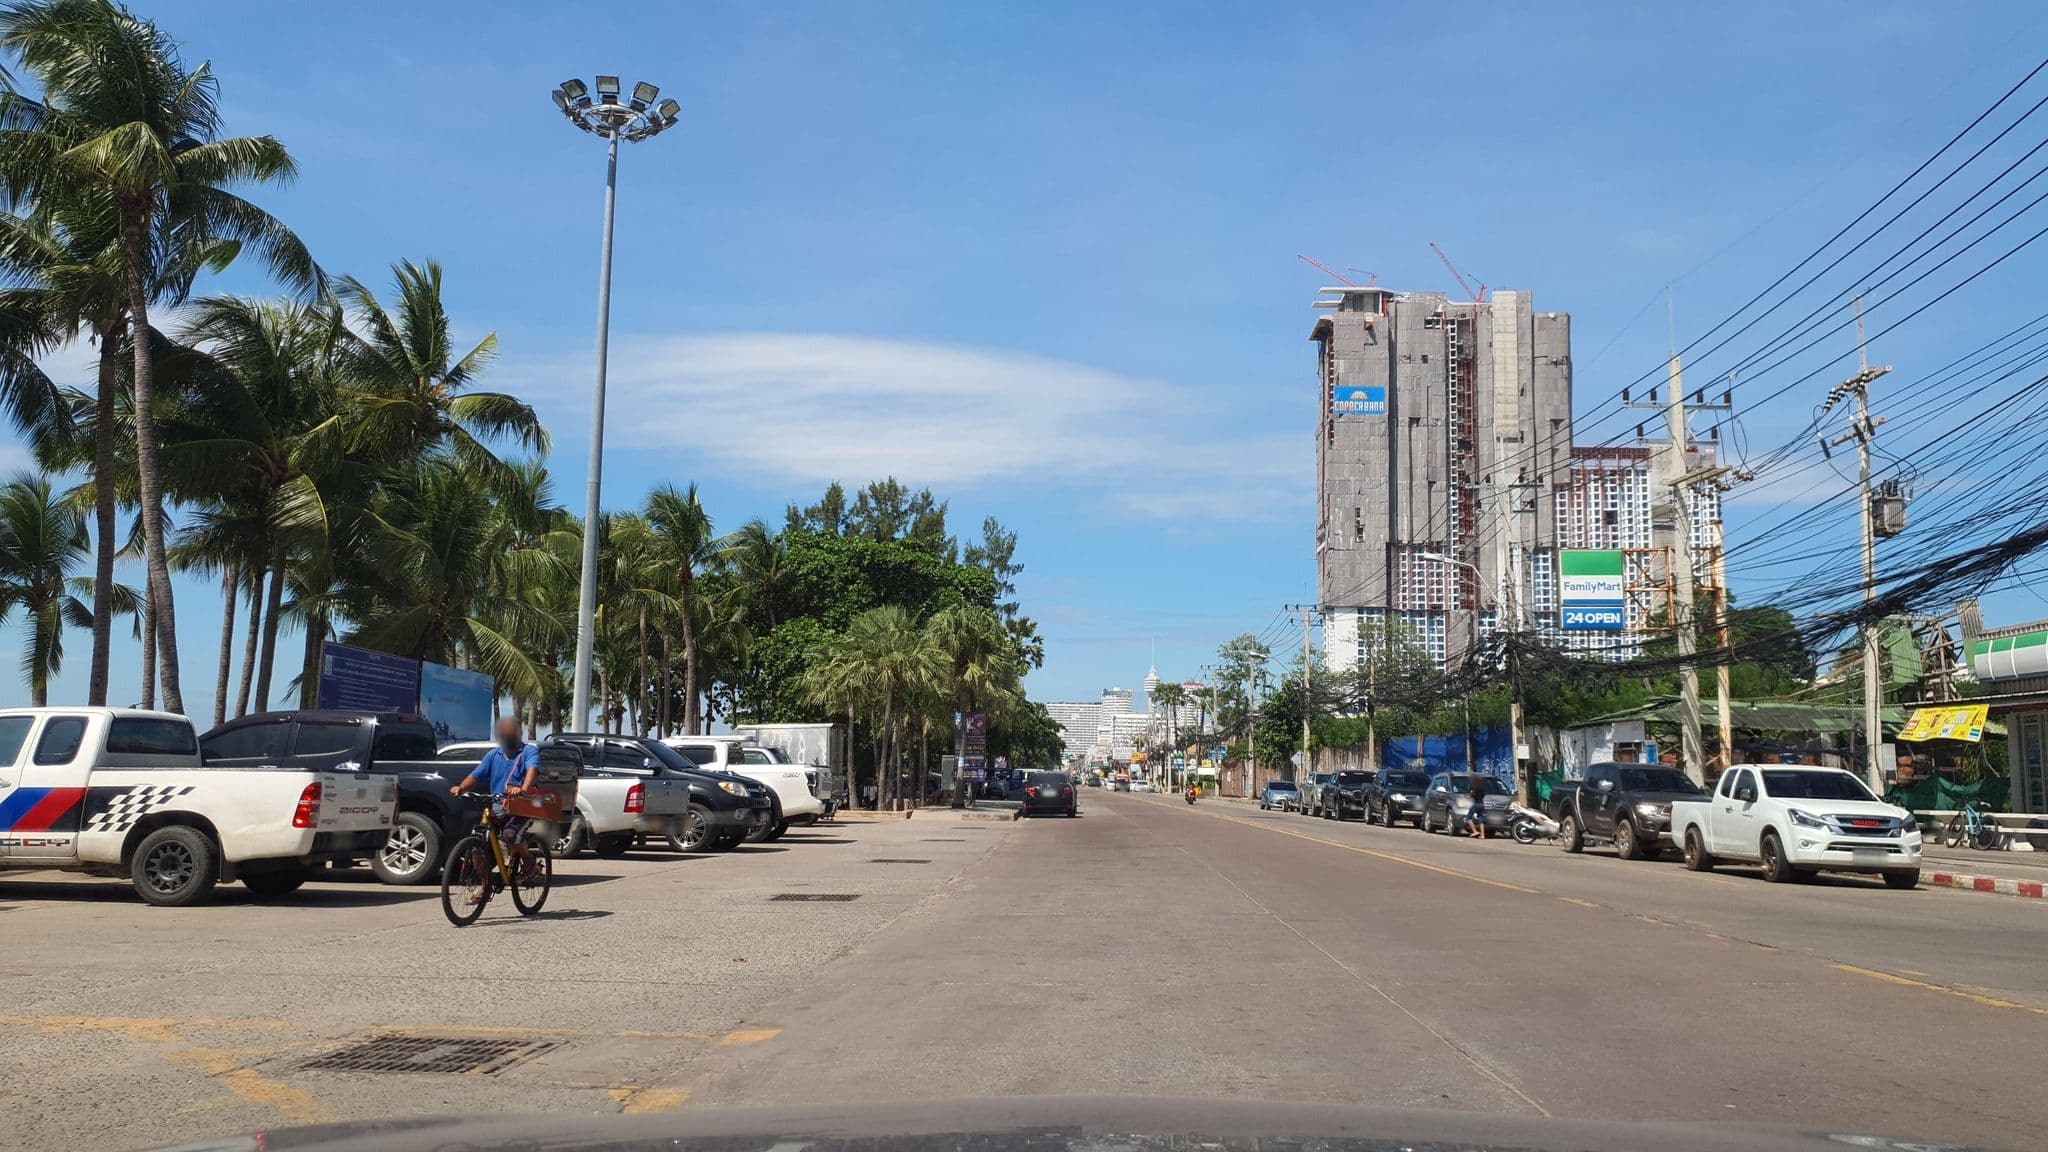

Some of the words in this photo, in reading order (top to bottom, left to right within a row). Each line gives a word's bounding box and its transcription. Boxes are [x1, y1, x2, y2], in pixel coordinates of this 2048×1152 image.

[1564, 582, 1621, 593] FamilyMart
[1566, 612, 1583, 624] 24
[1585, 612, 1620, 624] OPEN
